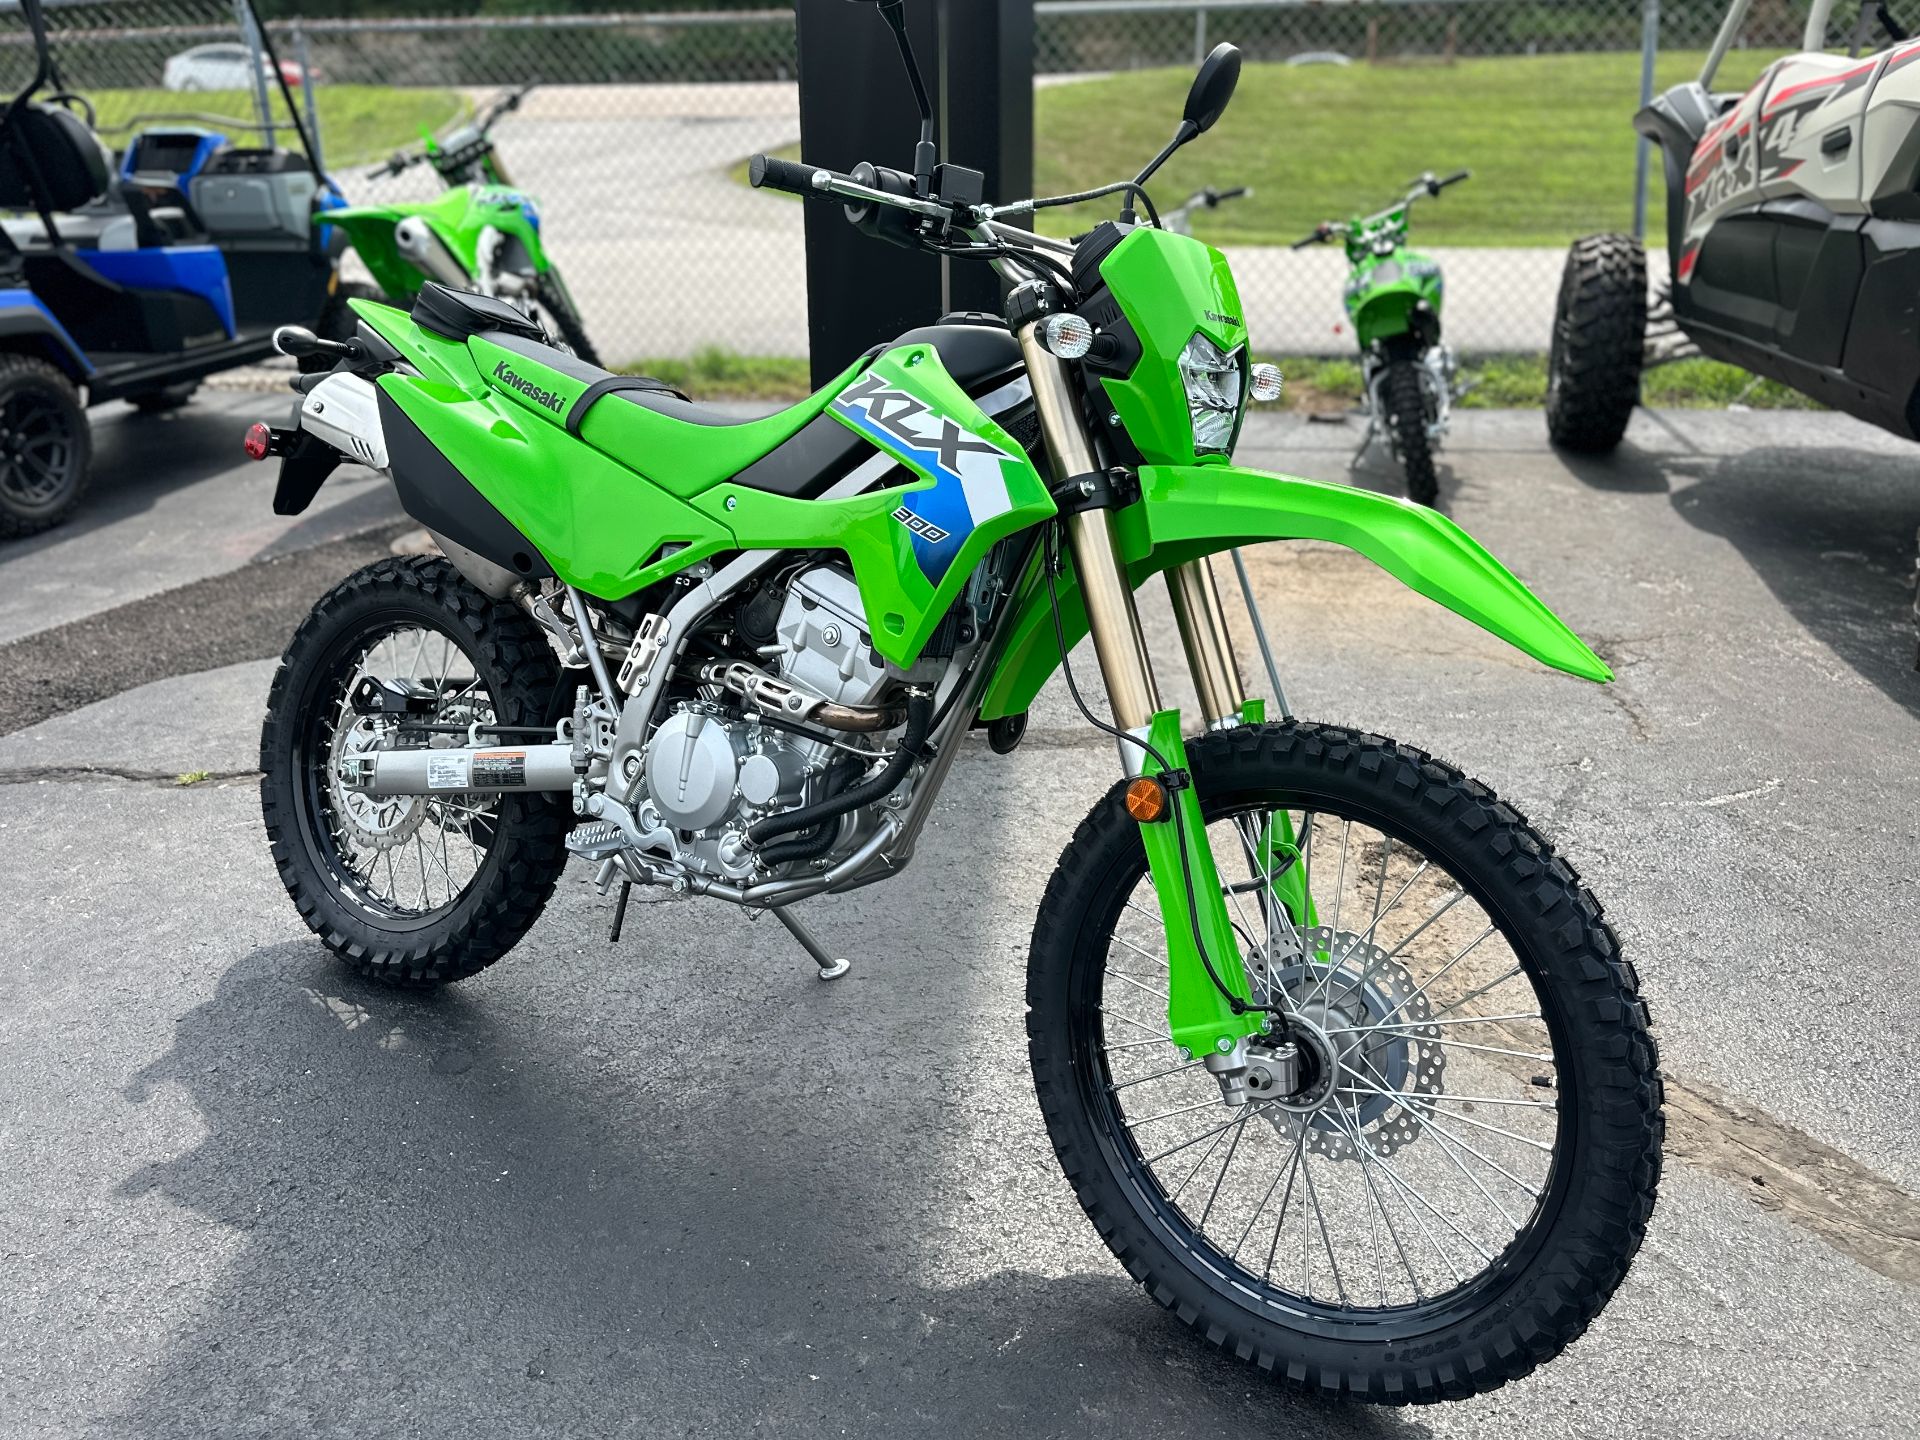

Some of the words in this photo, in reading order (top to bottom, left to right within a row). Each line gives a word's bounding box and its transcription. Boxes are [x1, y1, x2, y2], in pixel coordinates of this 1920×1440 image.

[1203, 309, 1241, 328] Kawasaki
[492, 360, 567, 414] Kawasaki
[834, 370, 1011, 478] KLX
[890, 505, 951, 543] 300
